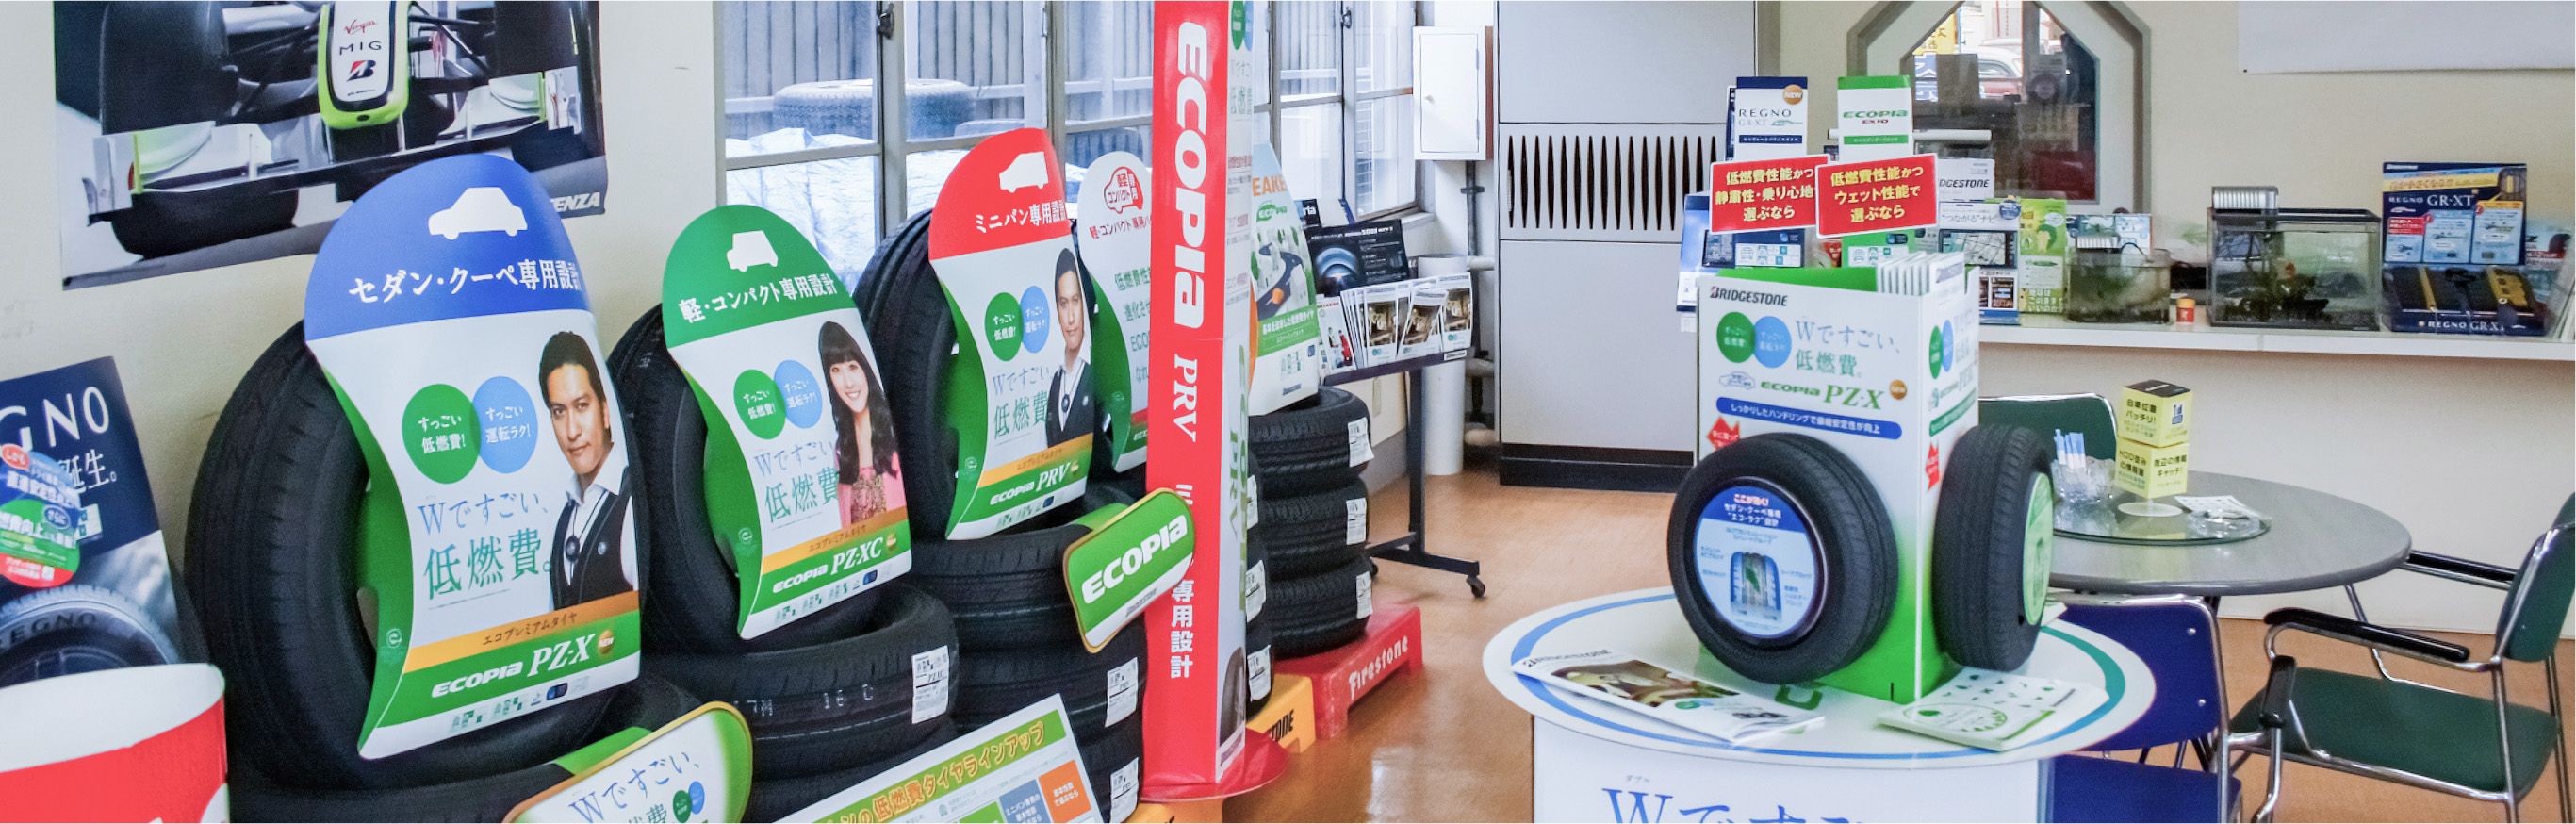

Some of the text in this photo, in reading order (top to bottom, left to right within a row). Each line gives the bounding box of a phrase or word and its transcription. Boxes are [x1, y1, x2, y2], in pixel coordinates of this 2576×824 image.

[1738, 108, 1792, 118] REGNO
[1726, 166, 1814, 187] 低燃費性能かつ
[1830, 165, 1924, 188] 低燃費性能かつ
[552, 191, 601, 213] ENZA
[1715, 185, 1815, 206] 静粛性・乗り心地
[1834, 184, 1921, 206] ウェット性能で
[1743, 205, 1796, 222] 選ぶなら
[1851, 203, 1906, 223] 選ぶなら
[1173, 354, 1198, 443] PRV
